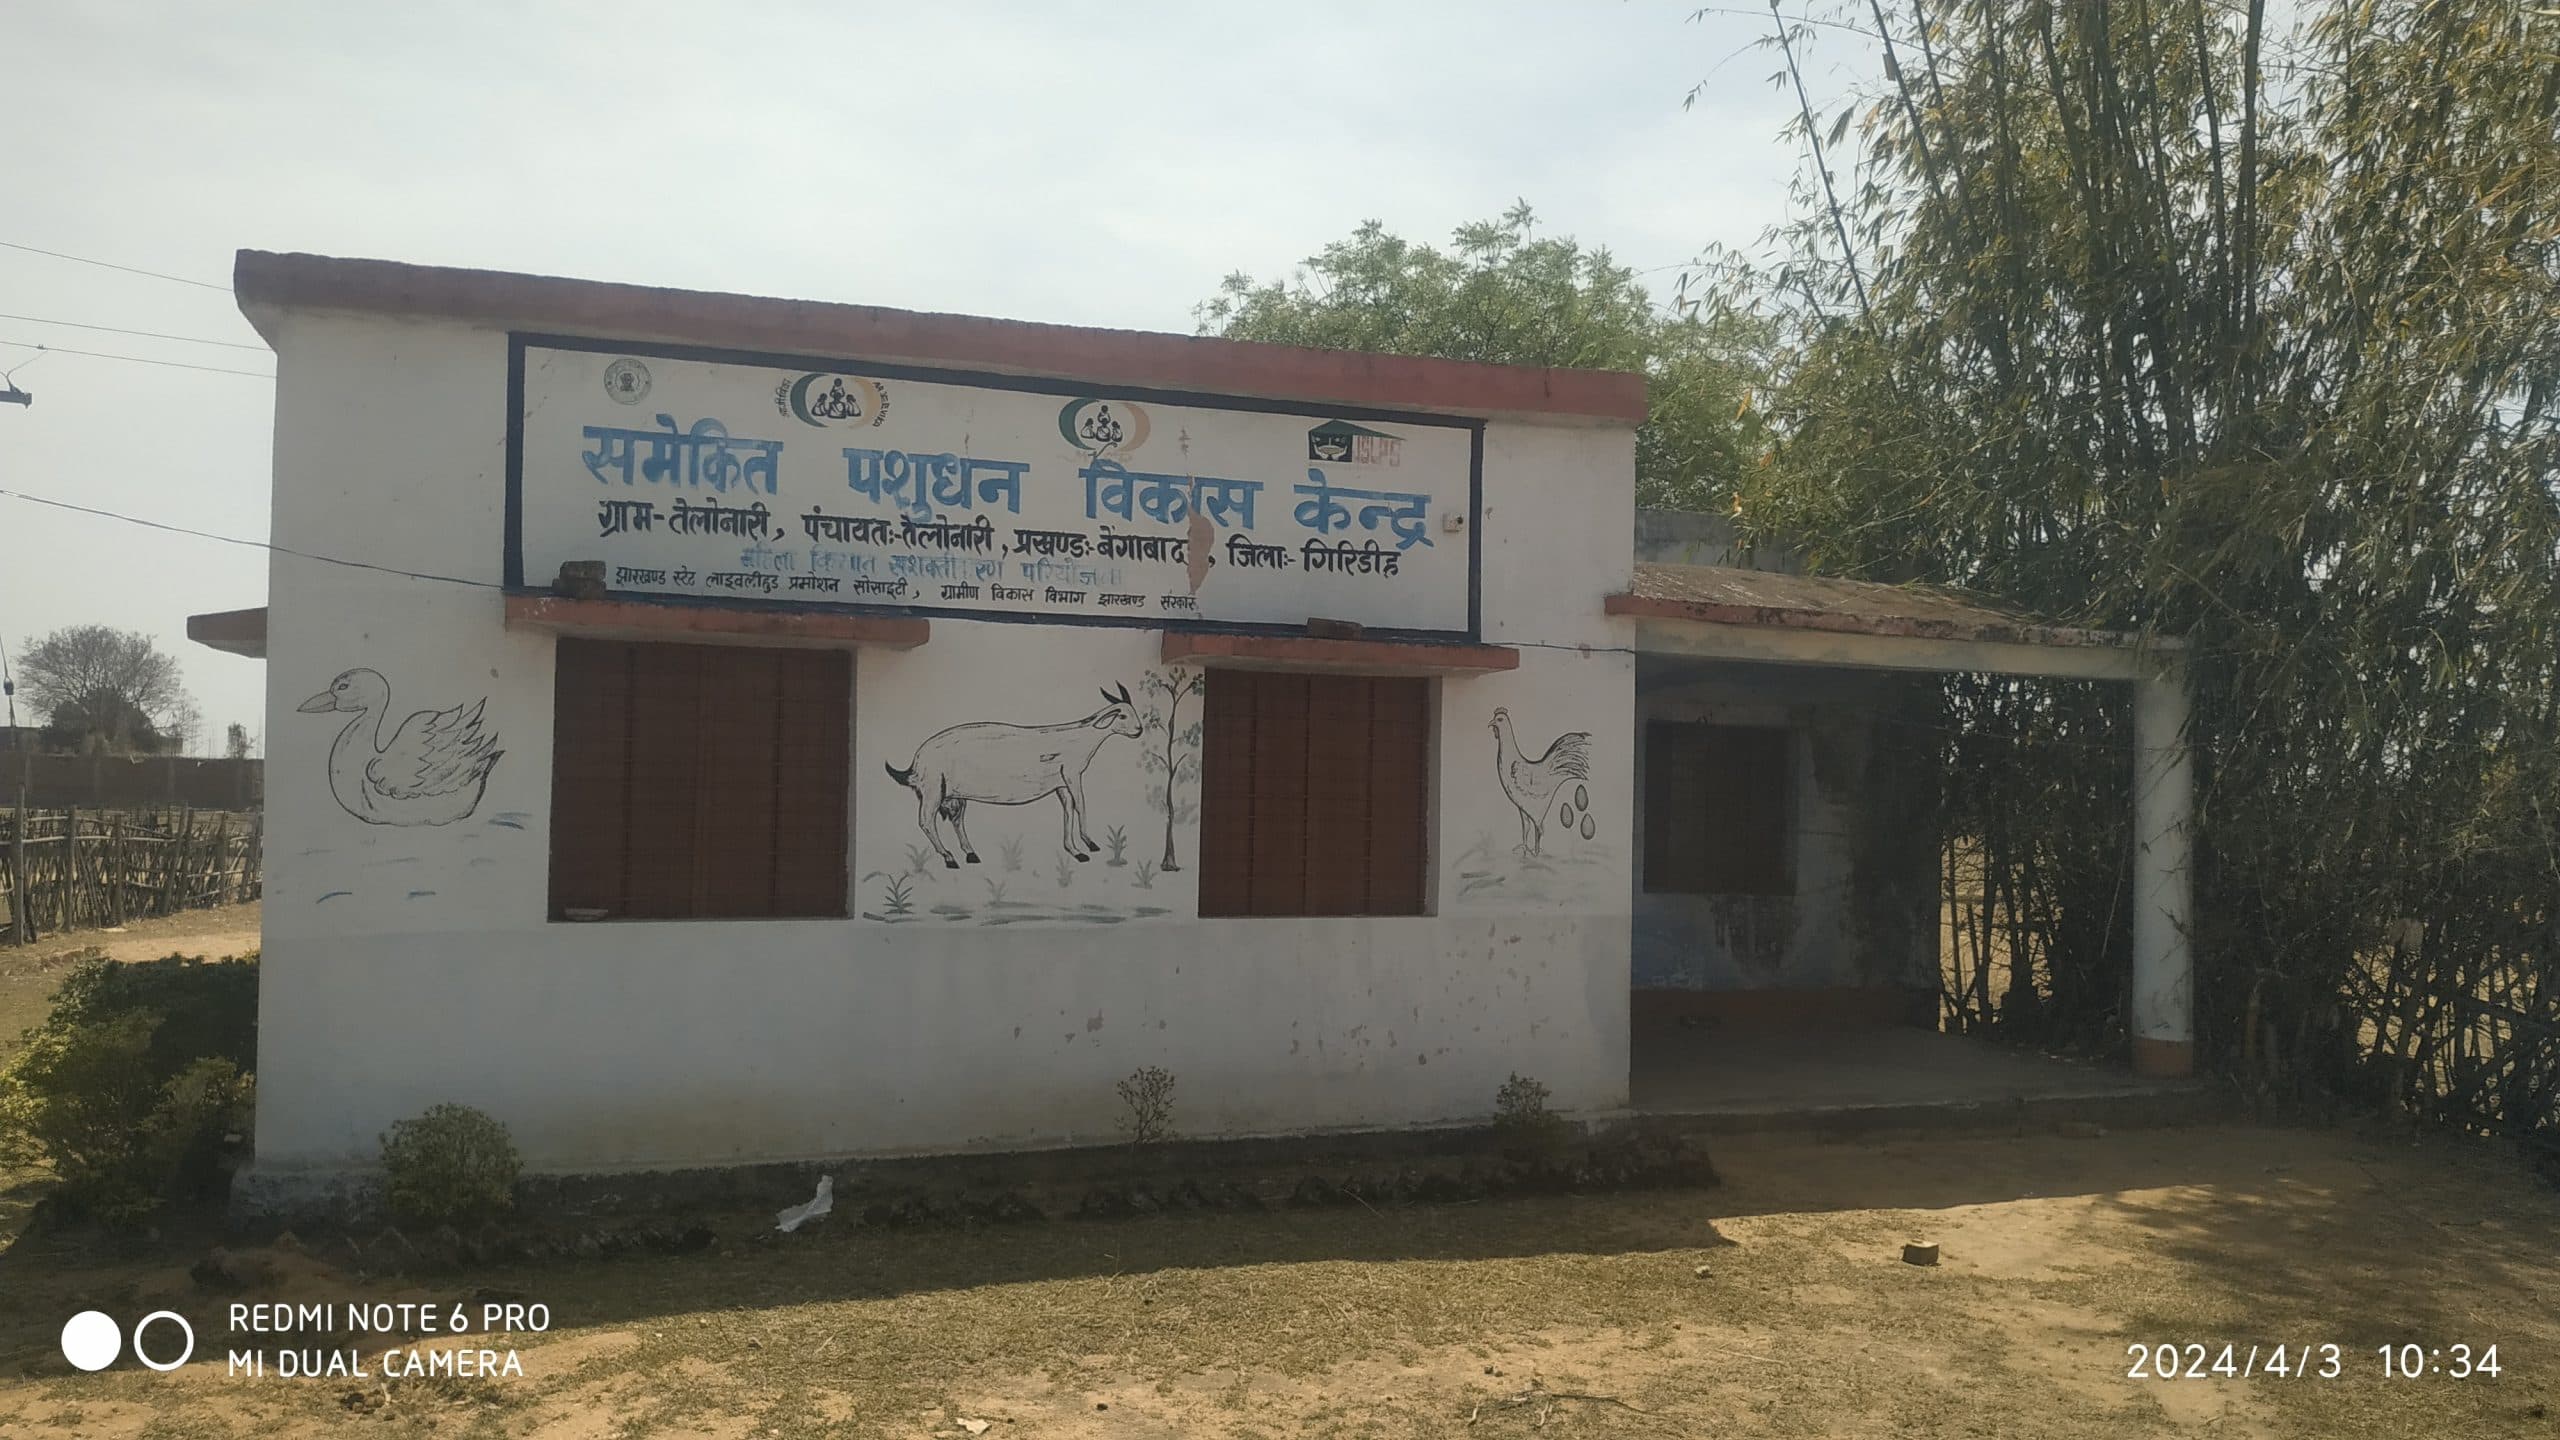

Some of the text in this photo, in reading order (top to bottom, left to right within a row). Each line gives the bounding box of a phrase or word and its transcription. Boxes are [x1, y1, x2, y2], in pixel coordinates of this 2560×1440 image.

[582, 413, 1434, 549] समेकित पशुधन विकास केन्द्र
[616, 566, 666, 586] झारखण्ड
[706, 570, 779, 594] लाइवलीहुड
[788, 570, 840, 593] प्रमोशन
[940, 580, 980, 601] ग्रामीण
[991, 583, 1035, 602] विकास
[1045, 587, 1087, 606] विभाग
[1097, 593, 1146, 607] झारखण्ड
